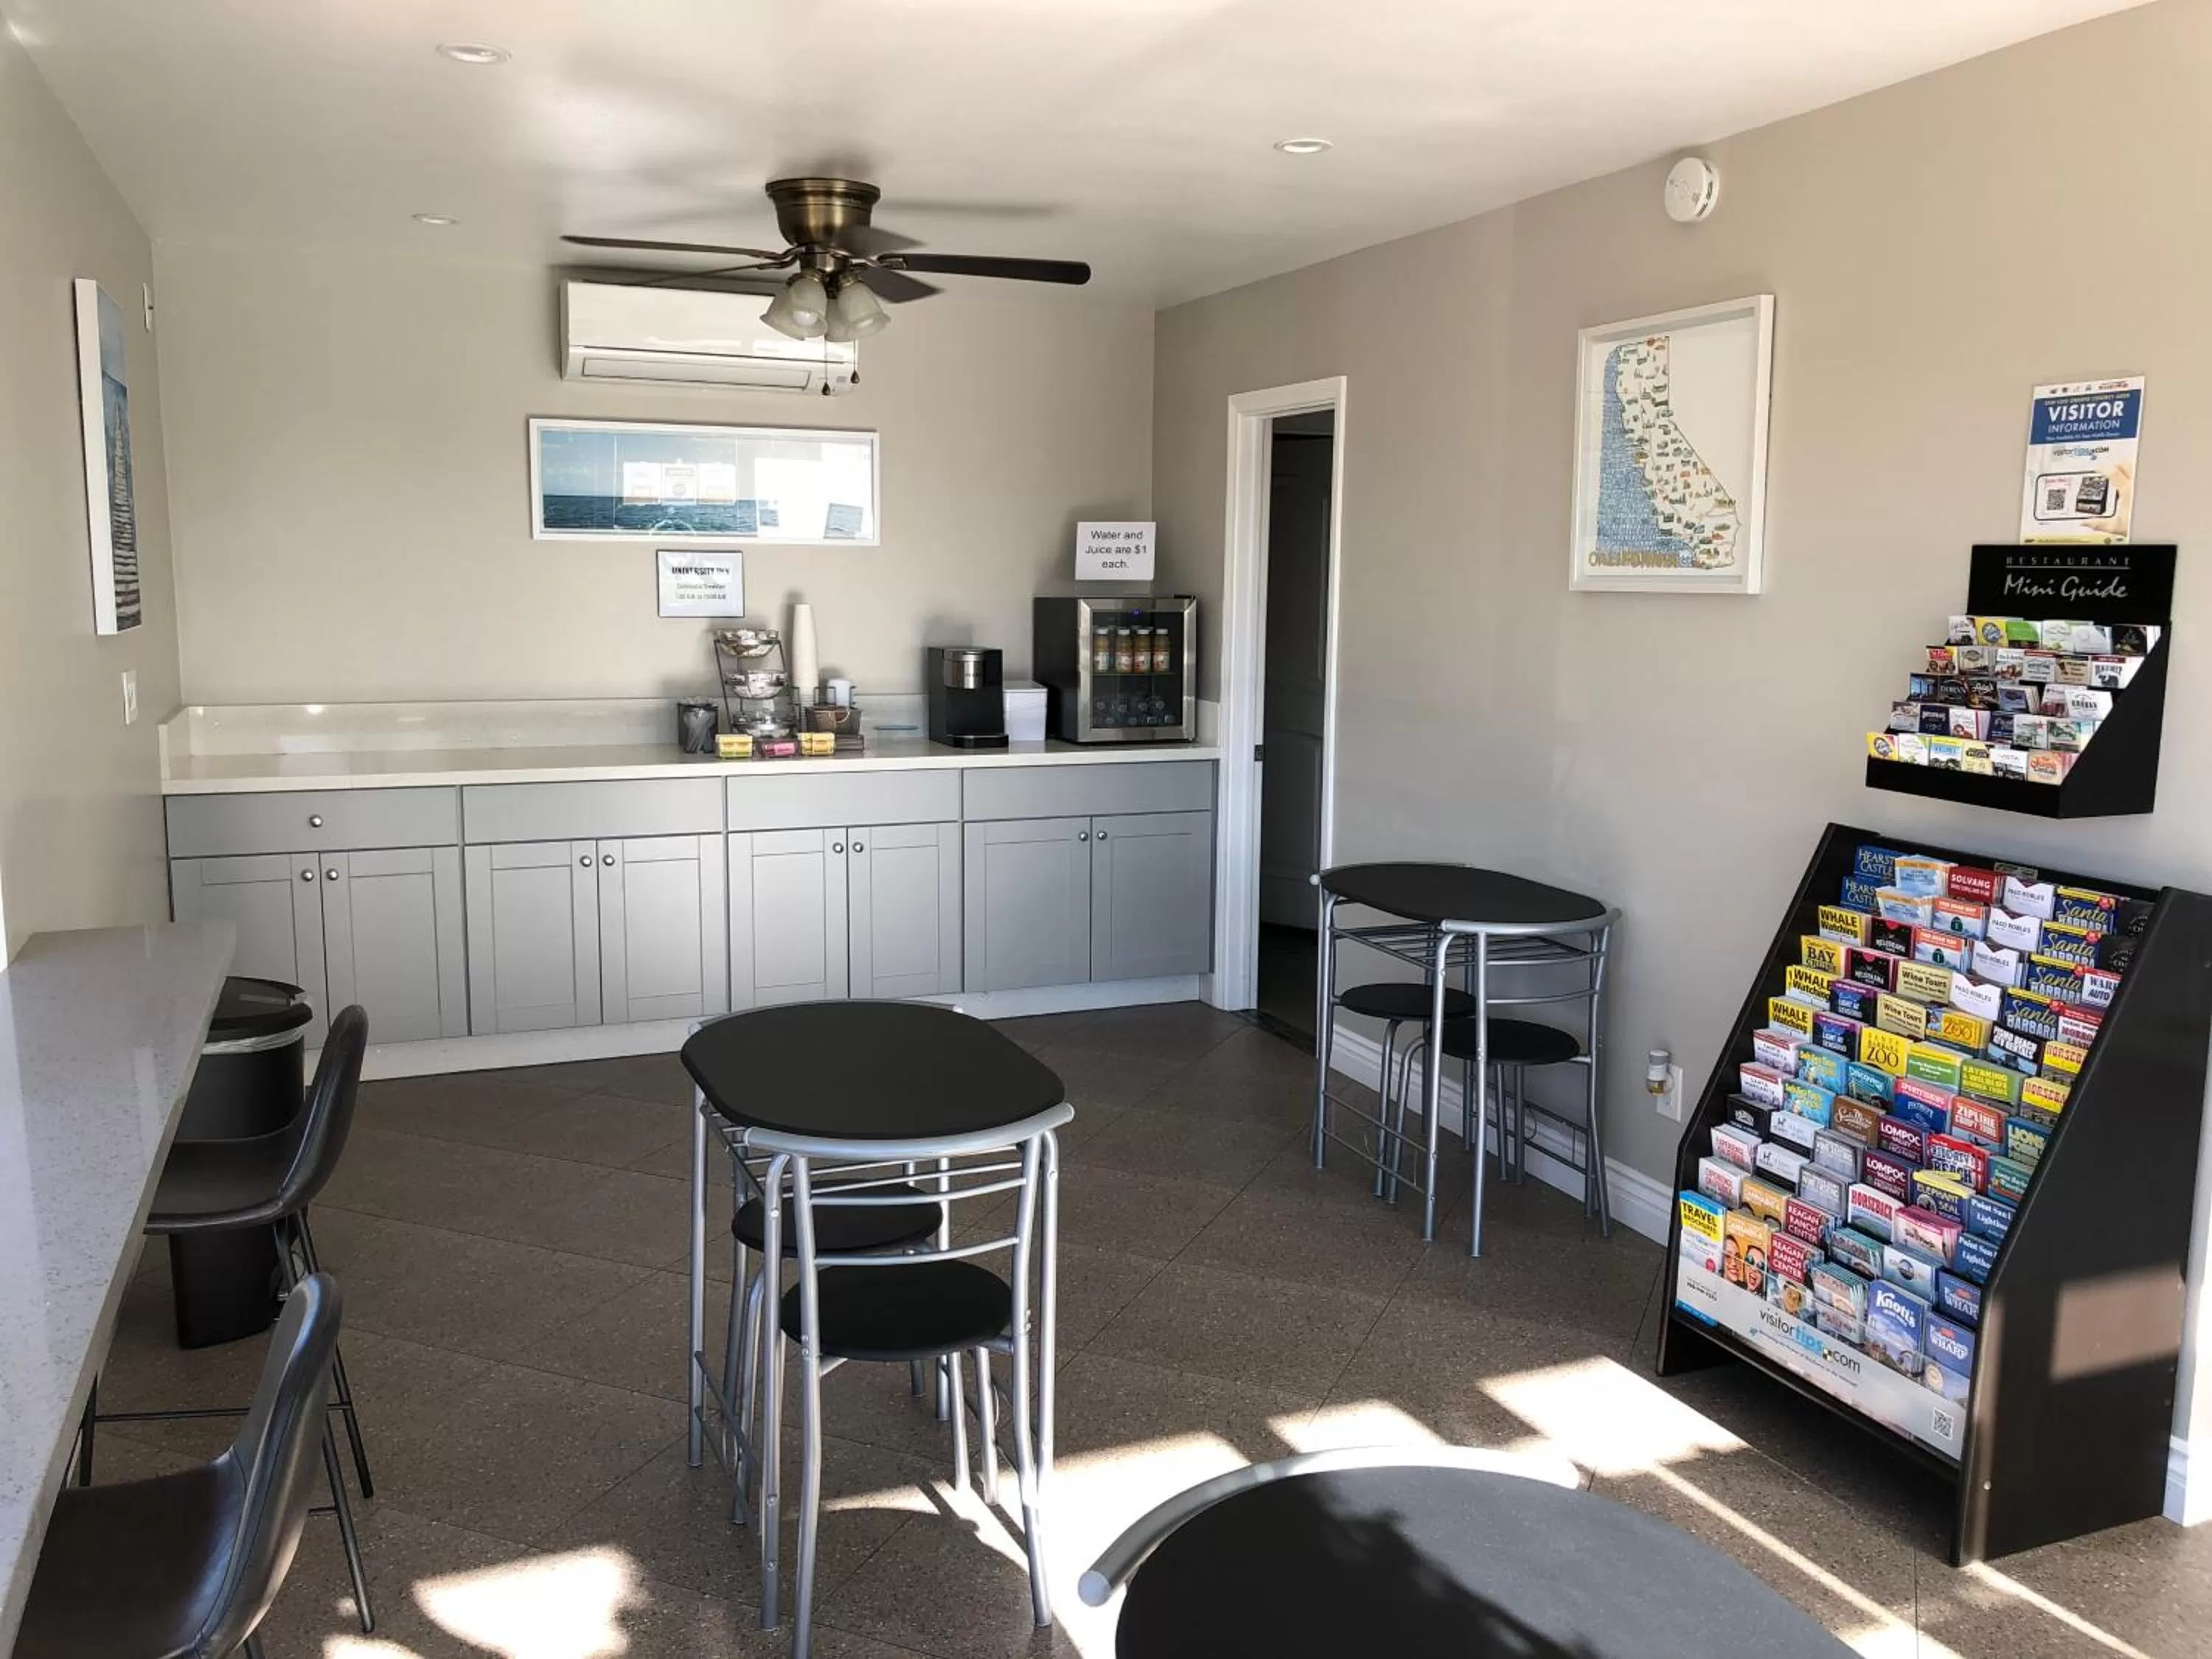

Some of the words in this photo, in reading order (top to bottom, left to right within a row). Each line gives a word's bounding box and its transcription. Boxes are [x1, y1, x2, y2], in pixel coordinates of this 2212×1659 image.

[2048, 400, 2125, 422] VISITOR
[2048, 419, 2121, 434] INFORMATION
[1091, 530, 1121, 540] Water
[1124, 530, 1144, 540] and
[1085, 545, 1113, 554] Juice
[1115, 546, 1132, 554] are
[1135, 545, 1147, 554] $1
[1102, 559, 1129, 569] each.
[2006, 556, 2131, 566] RESTAURANT
[2003, 573, 2056, 597] Mini
[2060, 575, 2129, 602] Guide
[1846, 879, 1877, 896] HEARS
[1951, 873, 1992, 889] SOLVANG
[1820, 910, 1858, 927] WHALE
[2056, 899, 2107, 922] Santa
[2041, 933, 2096, 956] Santa
[1806, 947, 1836, 963] BAY
[1902, 970, 1923, 982] Wine
[1924, 975, 1947, 989] Tours
[2028, 967, 2082, 990] Santa
[1772, 1001, 1809, 1018] WHALE
[1882, 1002, 1902, 1016] Wine
[1902, 1009, 1923, 1023] Tours
[2005, 999, 2058, 1025] Santa
[2006, 1014, 2056, 1040] BARBARA
[1866, 1046, 1899, 1068] ZOO
[1880, 1121, 1921, 1147] LOMPOC
[1865, 1157, 1906, 1182] LOMPOC
[1683, 1201, 1717, 1227] TRAVEL
[1787, 1205, 1819, 1225] REAGAN
[1787, 1216, 1818, 1234] RANCH
[1787, 1225, 1818, 1245] CENTER
[1773, 1238, 1805, 1259] REAGAN
[1773, 1250, 1803, 1270] RANCH
[1773, 1259, 1803, 1279] CENTER
[1876, 1290, 1916, 1328] Knott's
